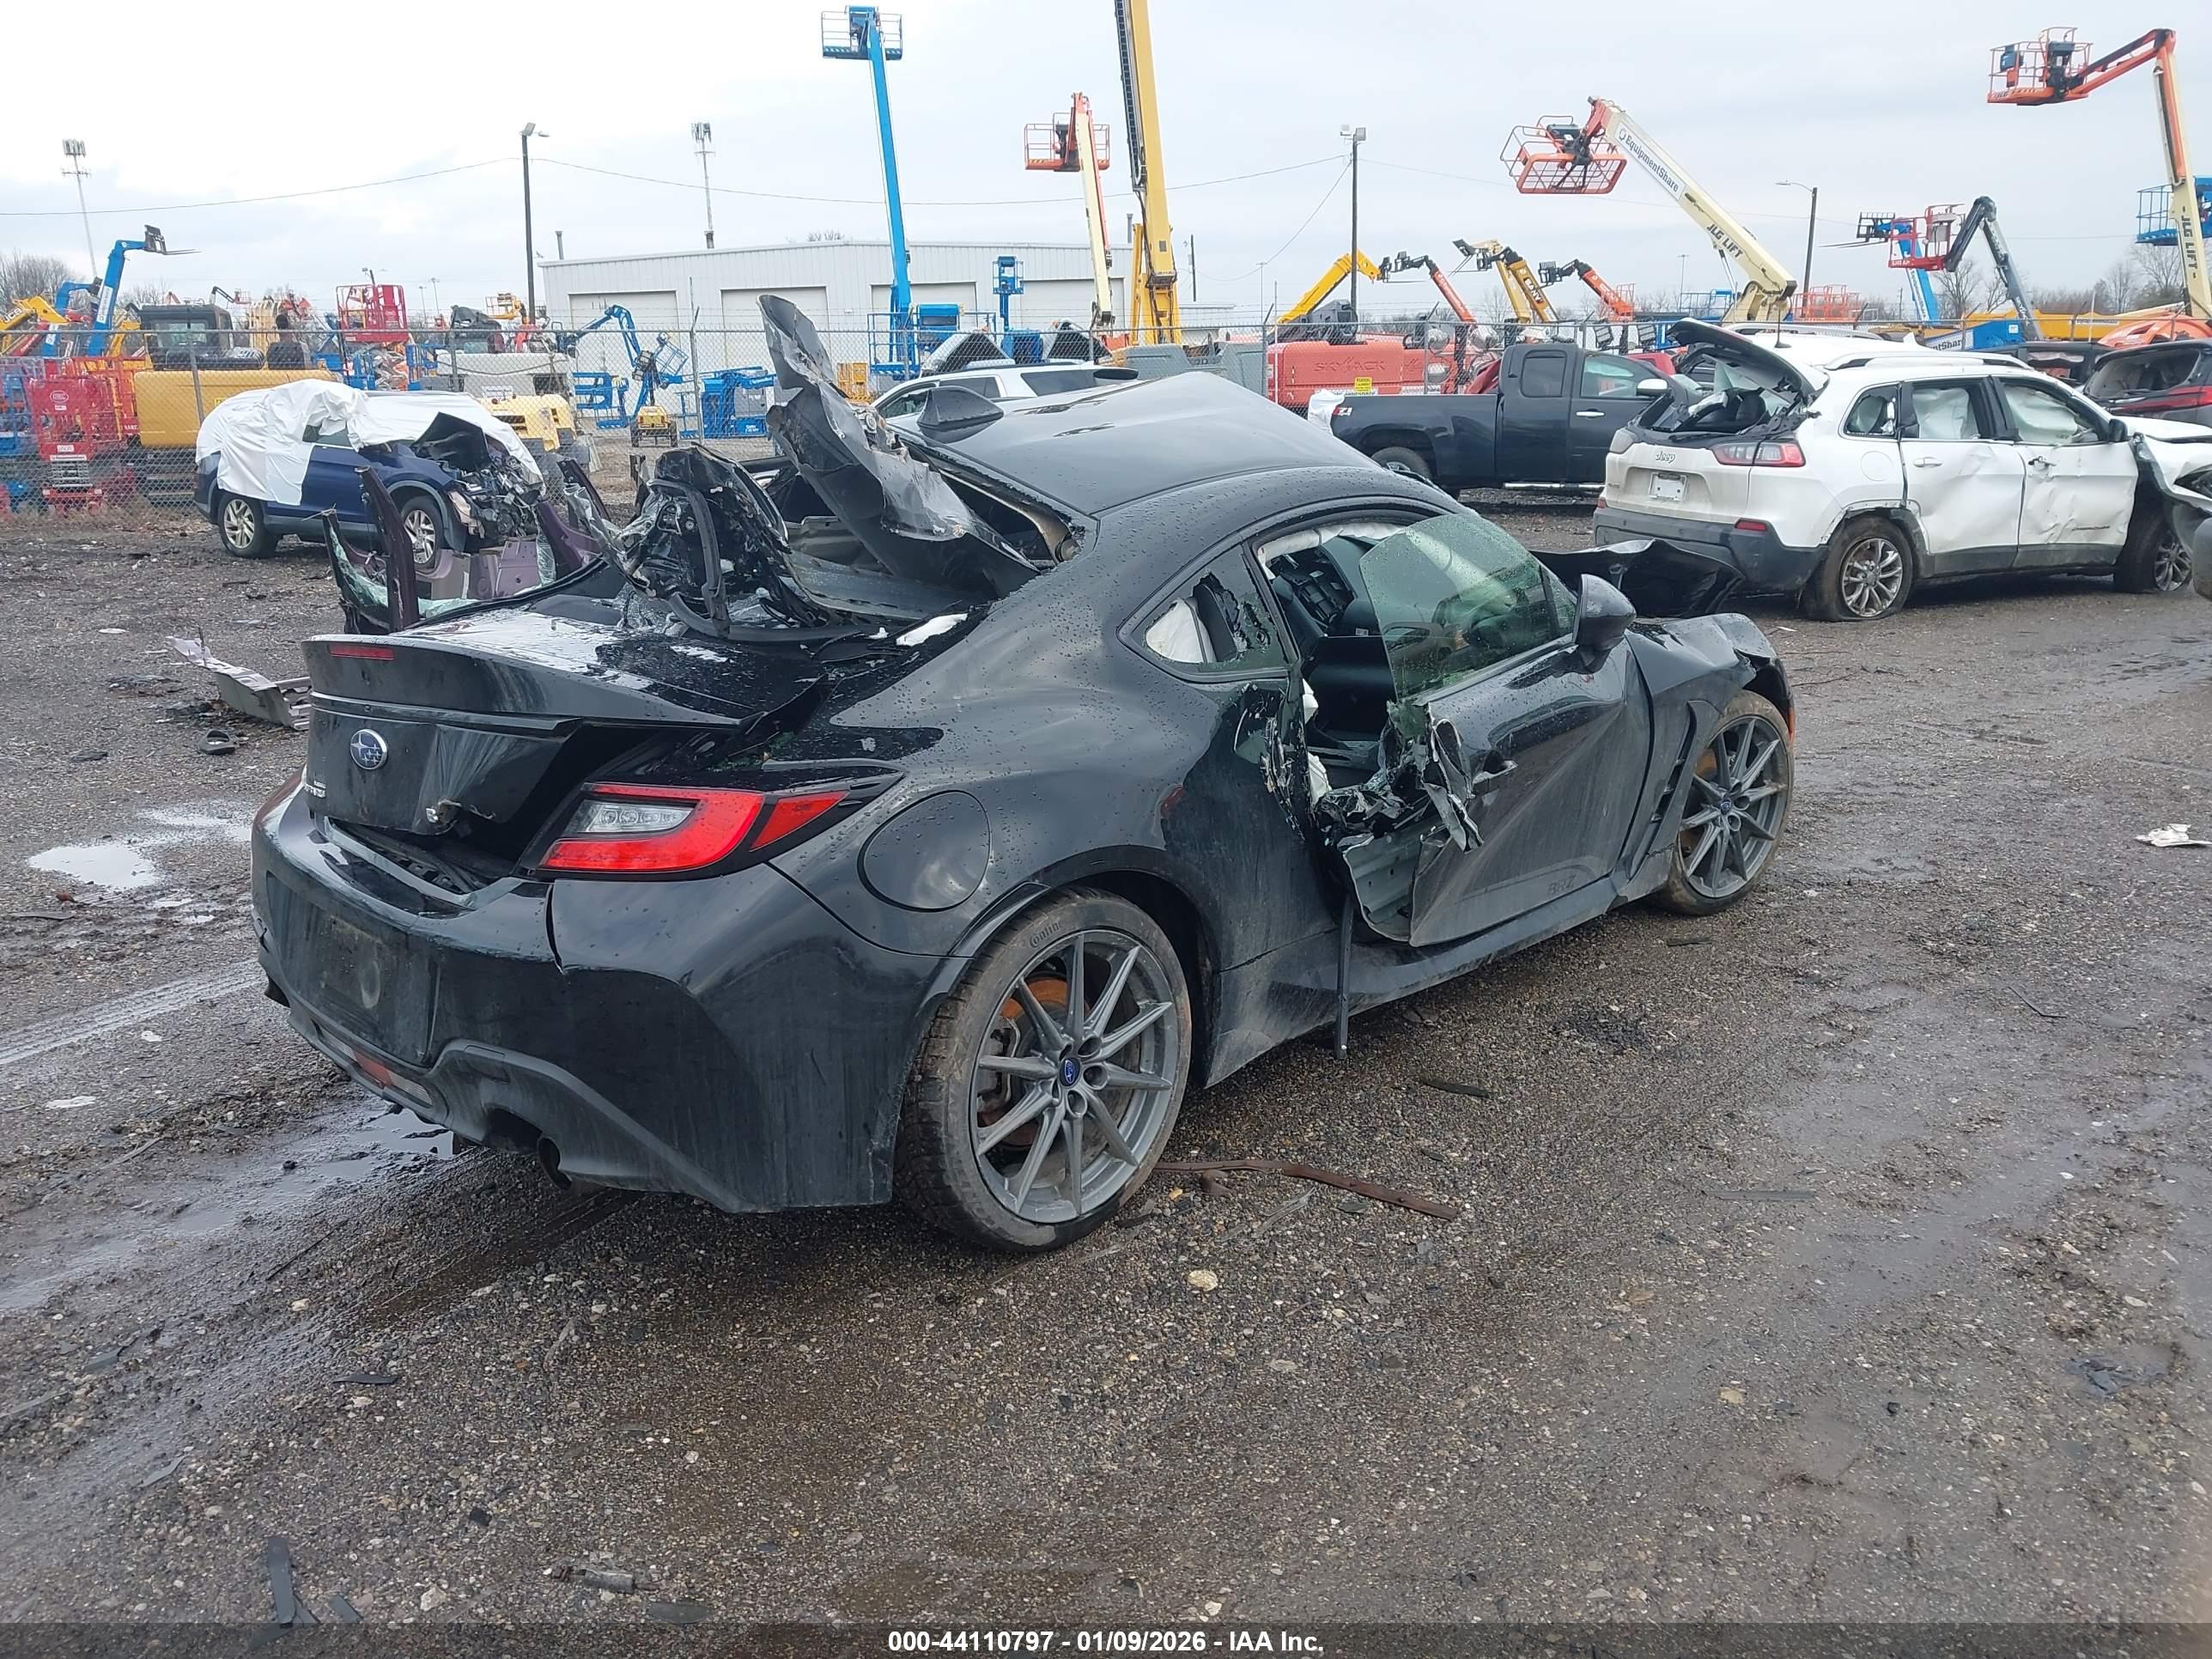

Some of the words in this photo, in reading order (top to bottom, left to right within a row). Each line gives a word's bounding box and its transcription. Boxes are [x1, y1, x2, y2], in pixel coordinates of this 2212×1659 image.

[1626, 134, 1680, 192] EquipmentShare
[2182, 216, 2193, 237] JLG
[1707, 223, 1725, 240] JLG
[1722, 237, 1744, 258] LIFT
[2185, 242, 2198, 269] LIFT
[3, 307, 22, 323] JCB
[1655, 451, 1676, 464] Jeep
